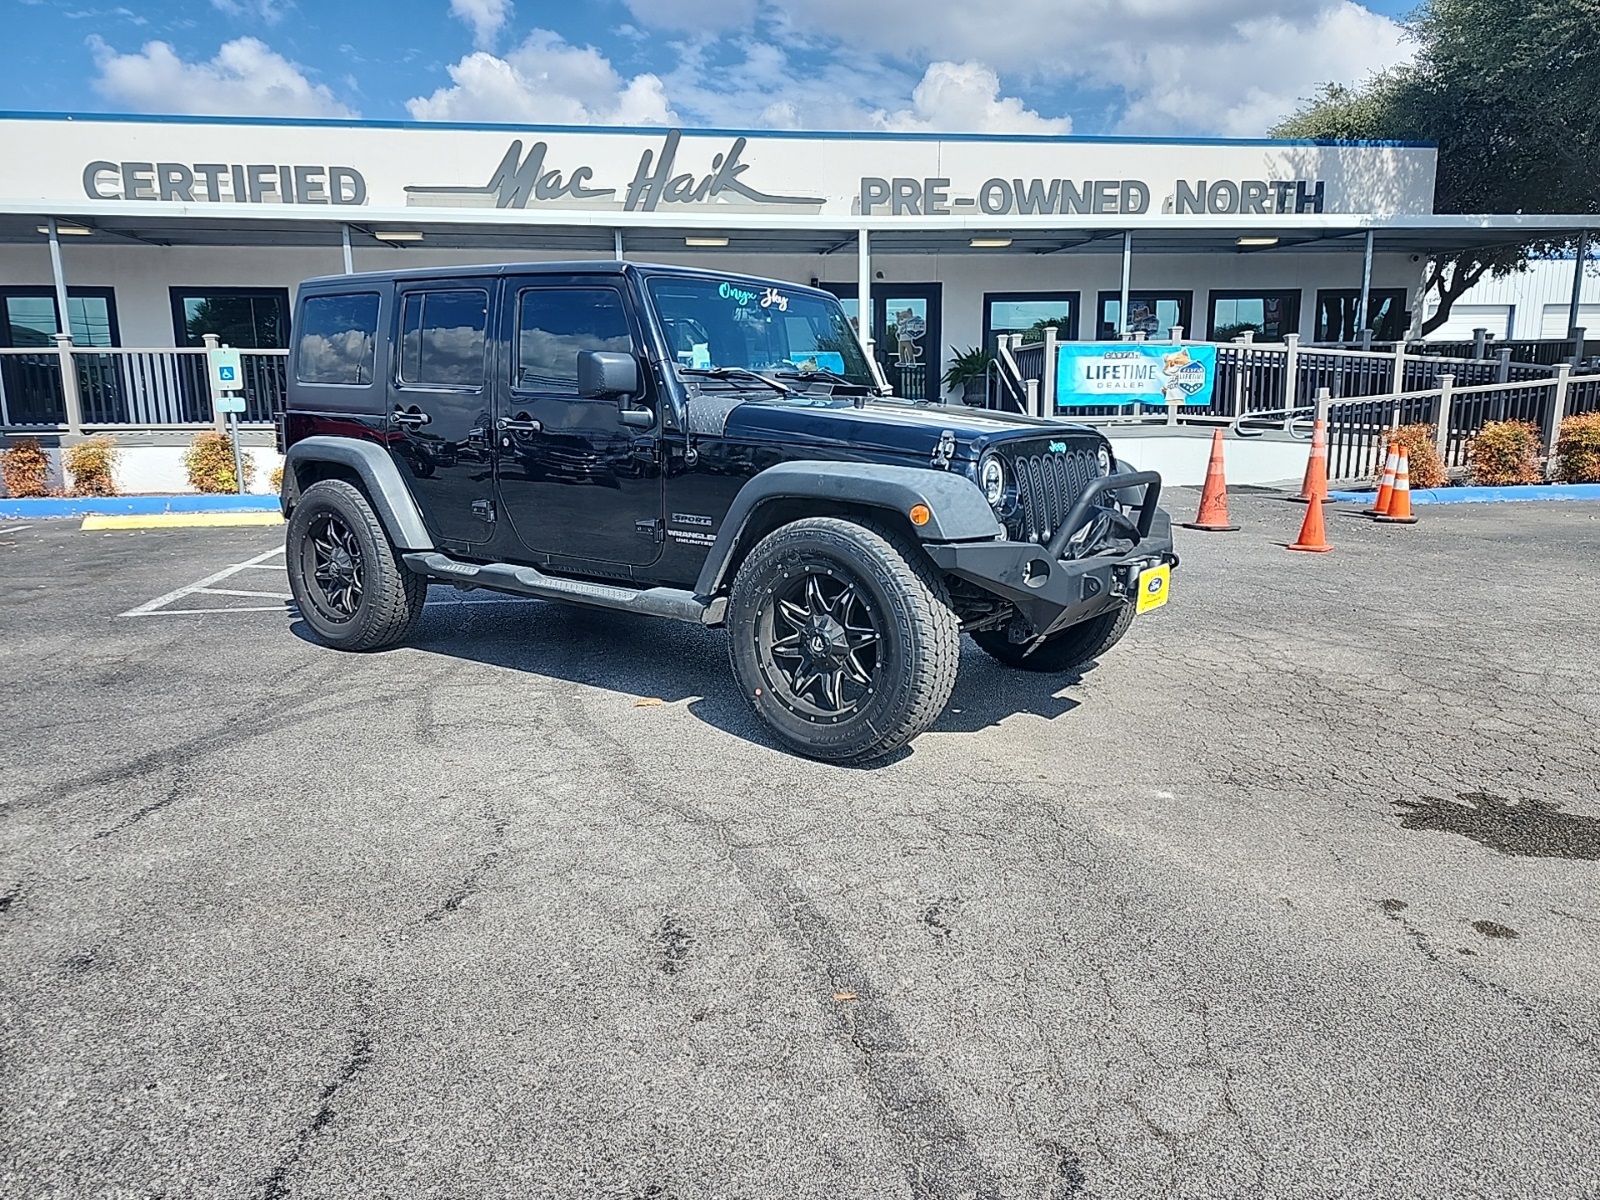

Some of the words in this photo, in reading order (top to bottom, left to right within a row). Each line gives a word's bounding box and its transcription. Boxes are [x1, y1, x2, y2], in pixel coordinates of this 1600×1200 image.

[404, 140, 615, 209] Mac
[624, 128, 827, 212] Haik
[82, 160, 367, 206] CERTIFIED
[860, 177, 1150, 215] PRE-OWNED
[1176, 179, 1325, 215] NORTH
[719, 282, 757, 305] Onyx
[1086, 364, 1157, 380] LIFETIME
[1049, 440, 1066, 453] Jeep
[673, 513, 710, 525] SPORT
[675, 537, 714, 547] UNLIMITED
